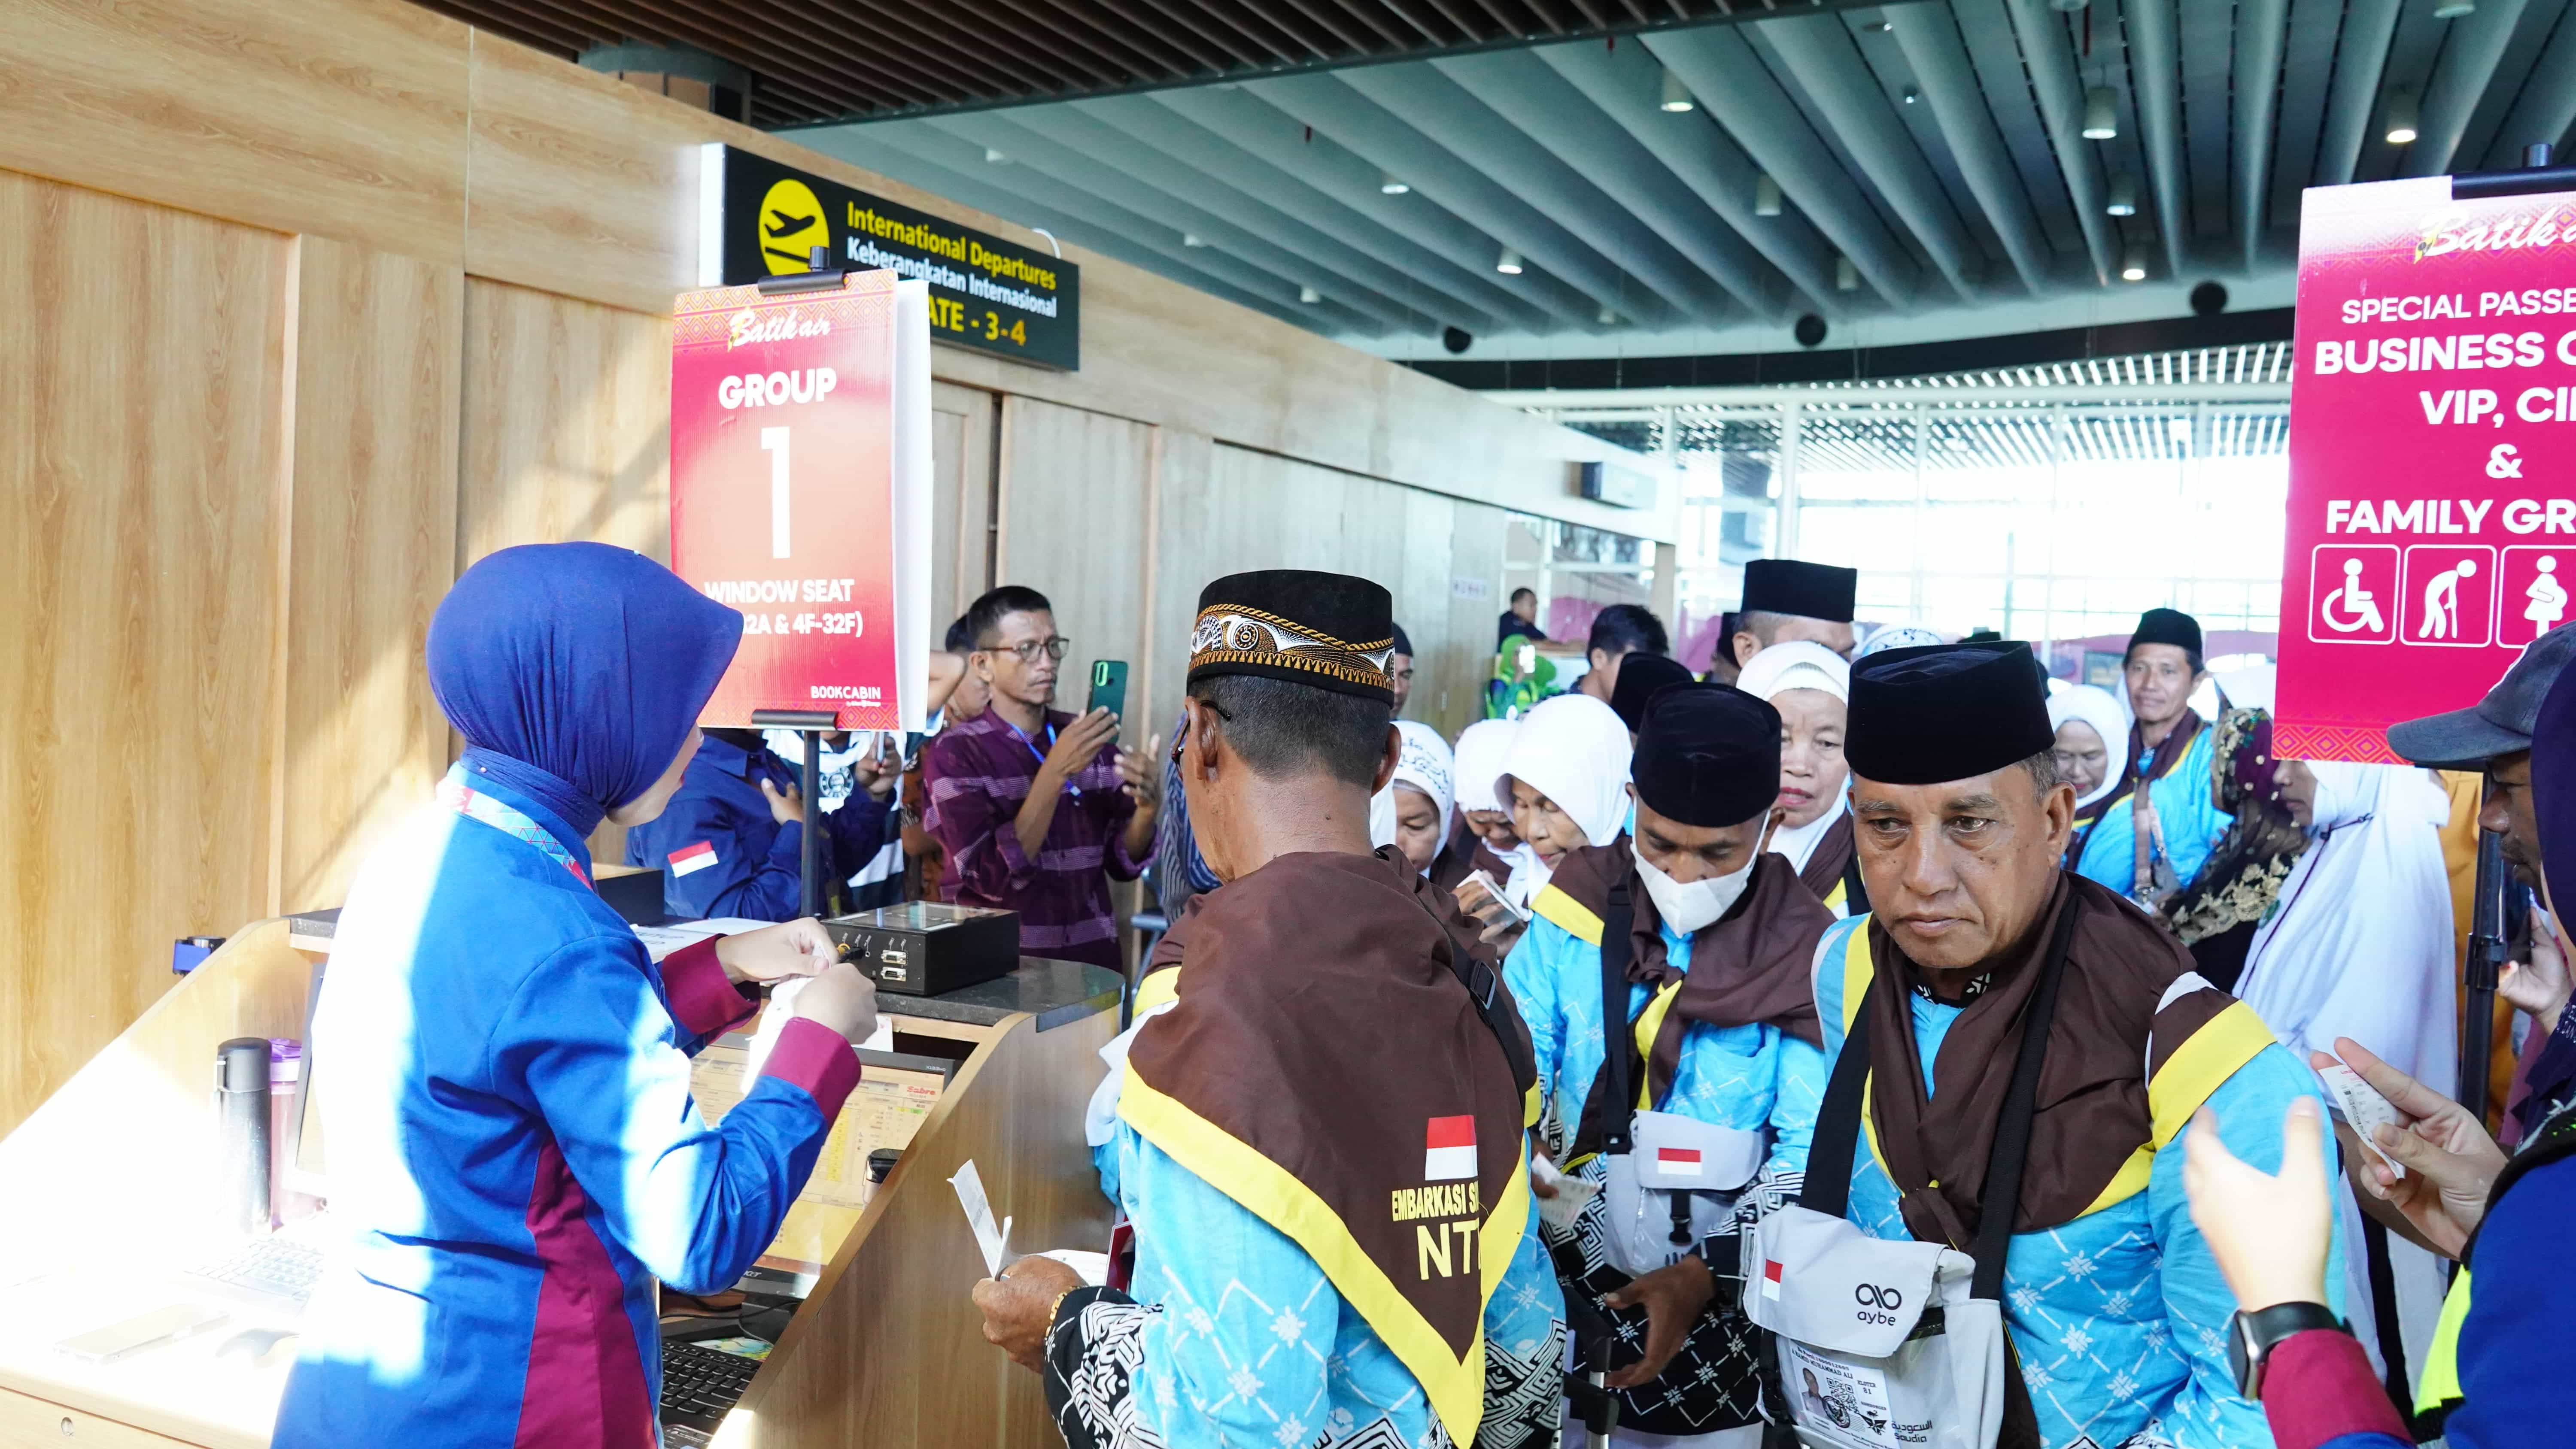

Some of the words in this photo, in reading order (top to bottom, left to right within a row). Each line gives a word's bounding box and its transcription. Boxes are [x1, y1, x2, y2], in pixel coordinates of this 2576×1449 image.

[847, 201, 966, 262] International
[969, 241, 1056, 291] Departures
[2417, 207, 2558, 257] Batik
[847, 236, 966, 292] Keberangkatan
[969, 273, 1057, 318] Internasional
[729, 308, 798, 347] Batik
[799, 316, 831, 337] air
[928, 294, 965, 333] ATE
[2342, 294, 2472, 324] SPECIAL
[2315, 332, 2545, 375] BUSINESS
[718, 367, 837, 409] GROUP
[2419, 389, 2504, 428] VIP,
[2516, 387, 2576, 423] CI
[2486, 443, 2523, 479] &
[761, 426, 790, 558] 1
[2327, 499, 2494, 534] FAMILY
[704, 580, 799, 603] WINDOW
[802, 578, 855, 602] SEAT
[775, 613, 790, 634] &
[792, 610, 863, 637] 4F-32F)
[811, 685, 881, 700] BOOKCABIN
[1391, 1183, 1467, 1222] EMBARKASI
[1417, 1217, 1481, 1280] NT
[1857, 1310, 1896, 1326] aybe
[1894, 1433, 1927, 1443] Saudia
